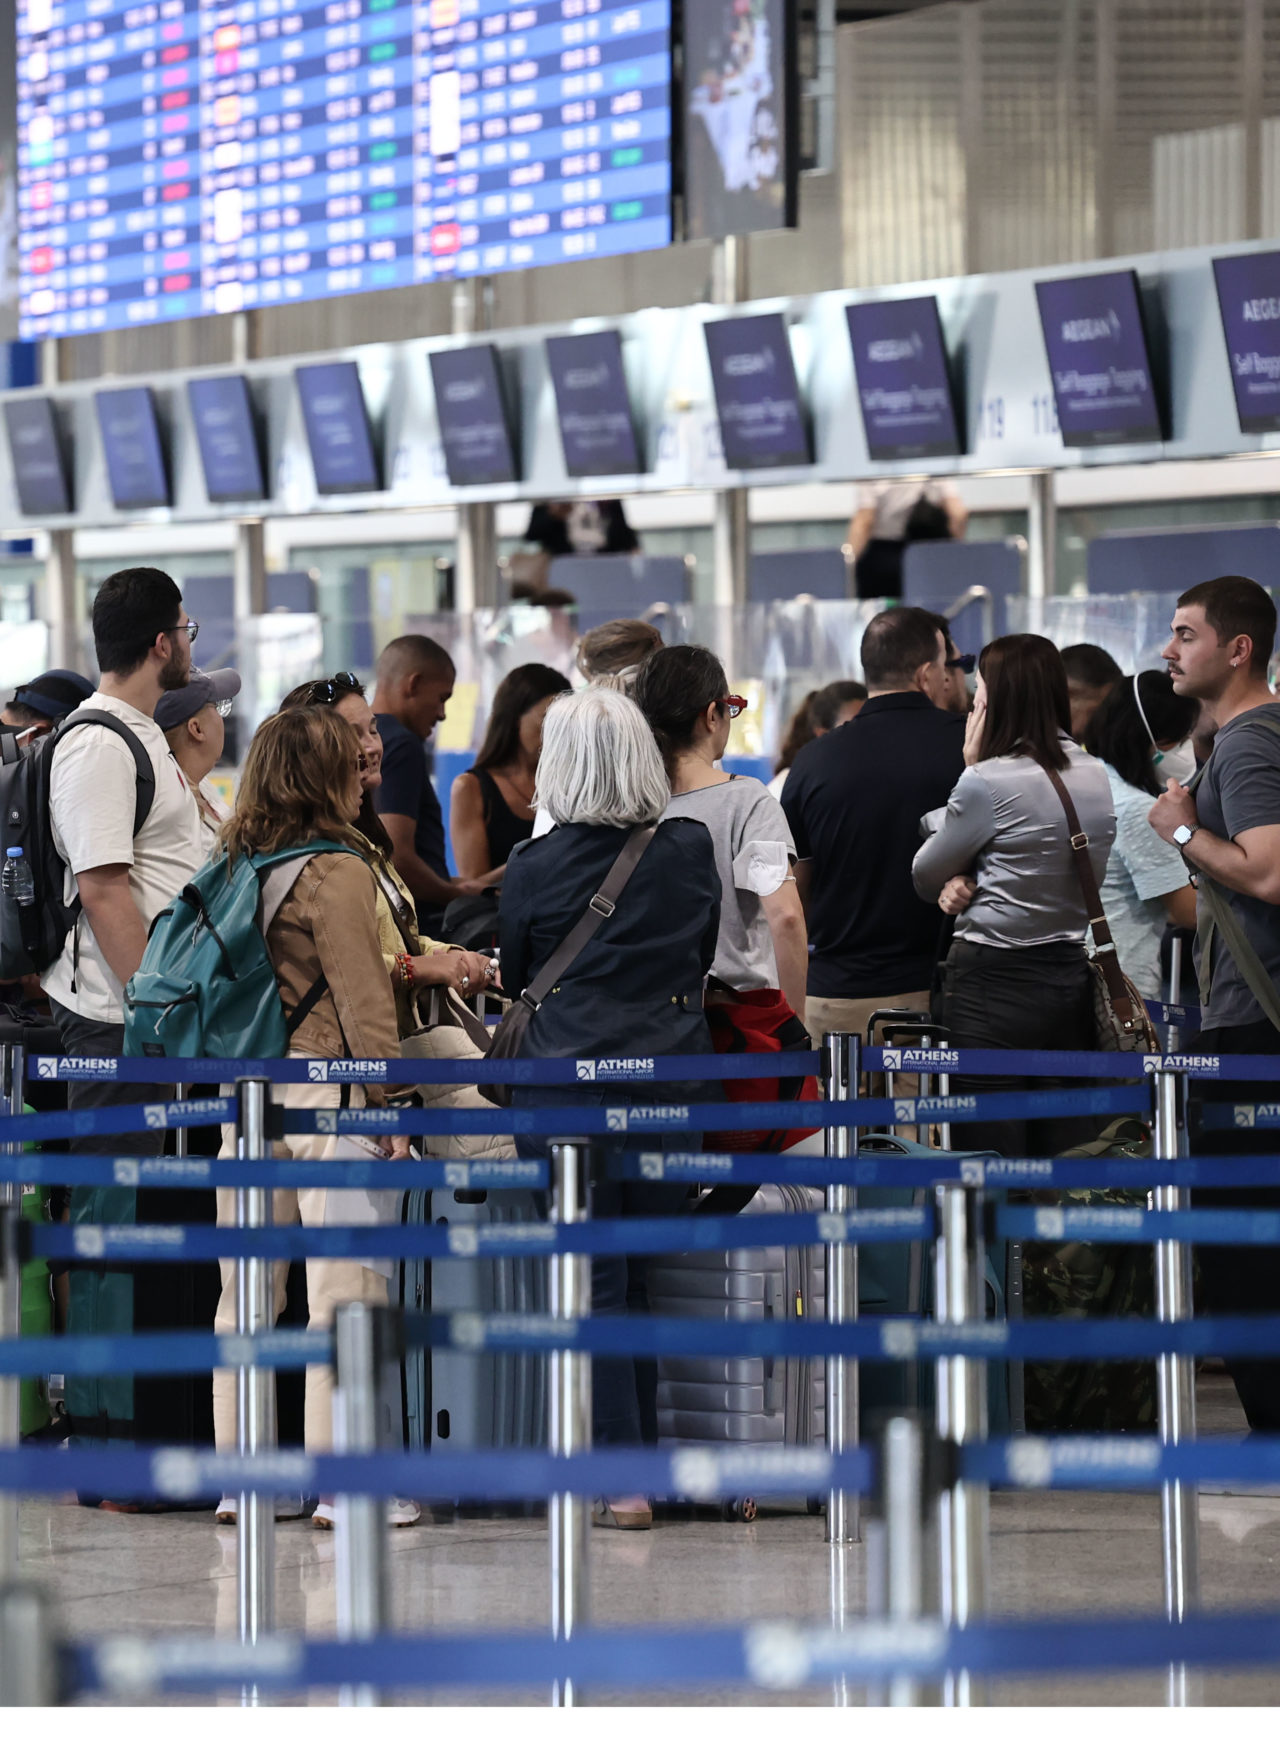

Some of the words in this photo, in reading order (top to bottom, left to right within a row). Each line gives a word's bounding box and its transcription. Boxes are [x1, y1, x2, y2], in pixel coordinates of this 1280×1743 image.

[903, 1050, 959, 1061] ATHENS
[1163, 1055, 1220, 1067] ATHENS
[59, 1057, 118, 1069] ATHENS
[330, 1060, 388, 1071] ATHENS
[597, 1058, 655, 1070] ATHENS
[167, 1098, 228, 1116] ATHENS
[917, 1096, 977, 1111] ATHENS
[338, 1110, 400, 1123] ATHENS
[628, 1106, 690, 1119] ATHENS
[140, 1159, 210, 1175] ATHENS
[665, 1153, 733, 1170] ATHENS
[986, 1159, 1053, 1175] ATHENS
[470, 1161, 539, 1176] ATHENS
